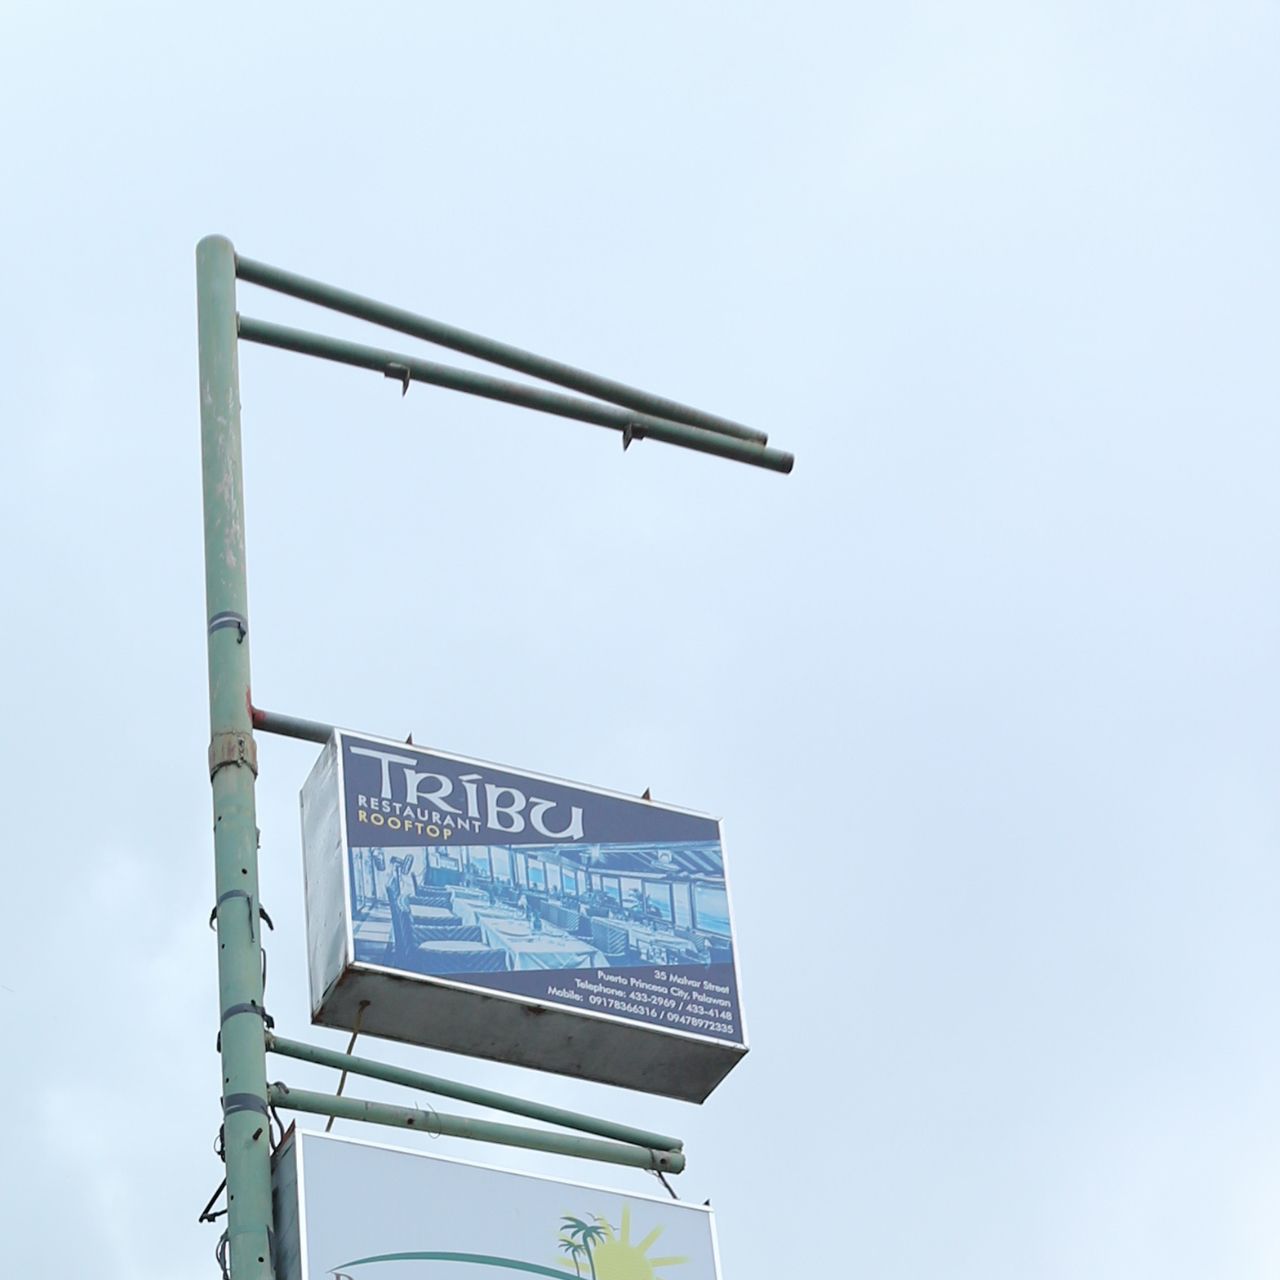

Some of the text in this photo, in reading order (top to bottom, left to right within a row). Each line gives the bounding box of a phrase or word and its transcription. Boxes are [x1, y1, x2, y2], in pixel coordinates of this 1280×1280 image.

[358, 794, 481, 834] RESTAURANT
[358, 810, 452, 840] ROOFTOP
[575, 978, 626, 998] Telephone:
[629, 991, 676, 1009] 433-2969
[685, 1004, 732, 1021] 433-4148
[597, 970, 732, 1007] Puerto Princesa City, Palawan
[654, 970, 730, 994] 35 Malvar Street
[548, 986, 584, 1002] Mobile:
[589, 996, 658, 1019] 09178366316
